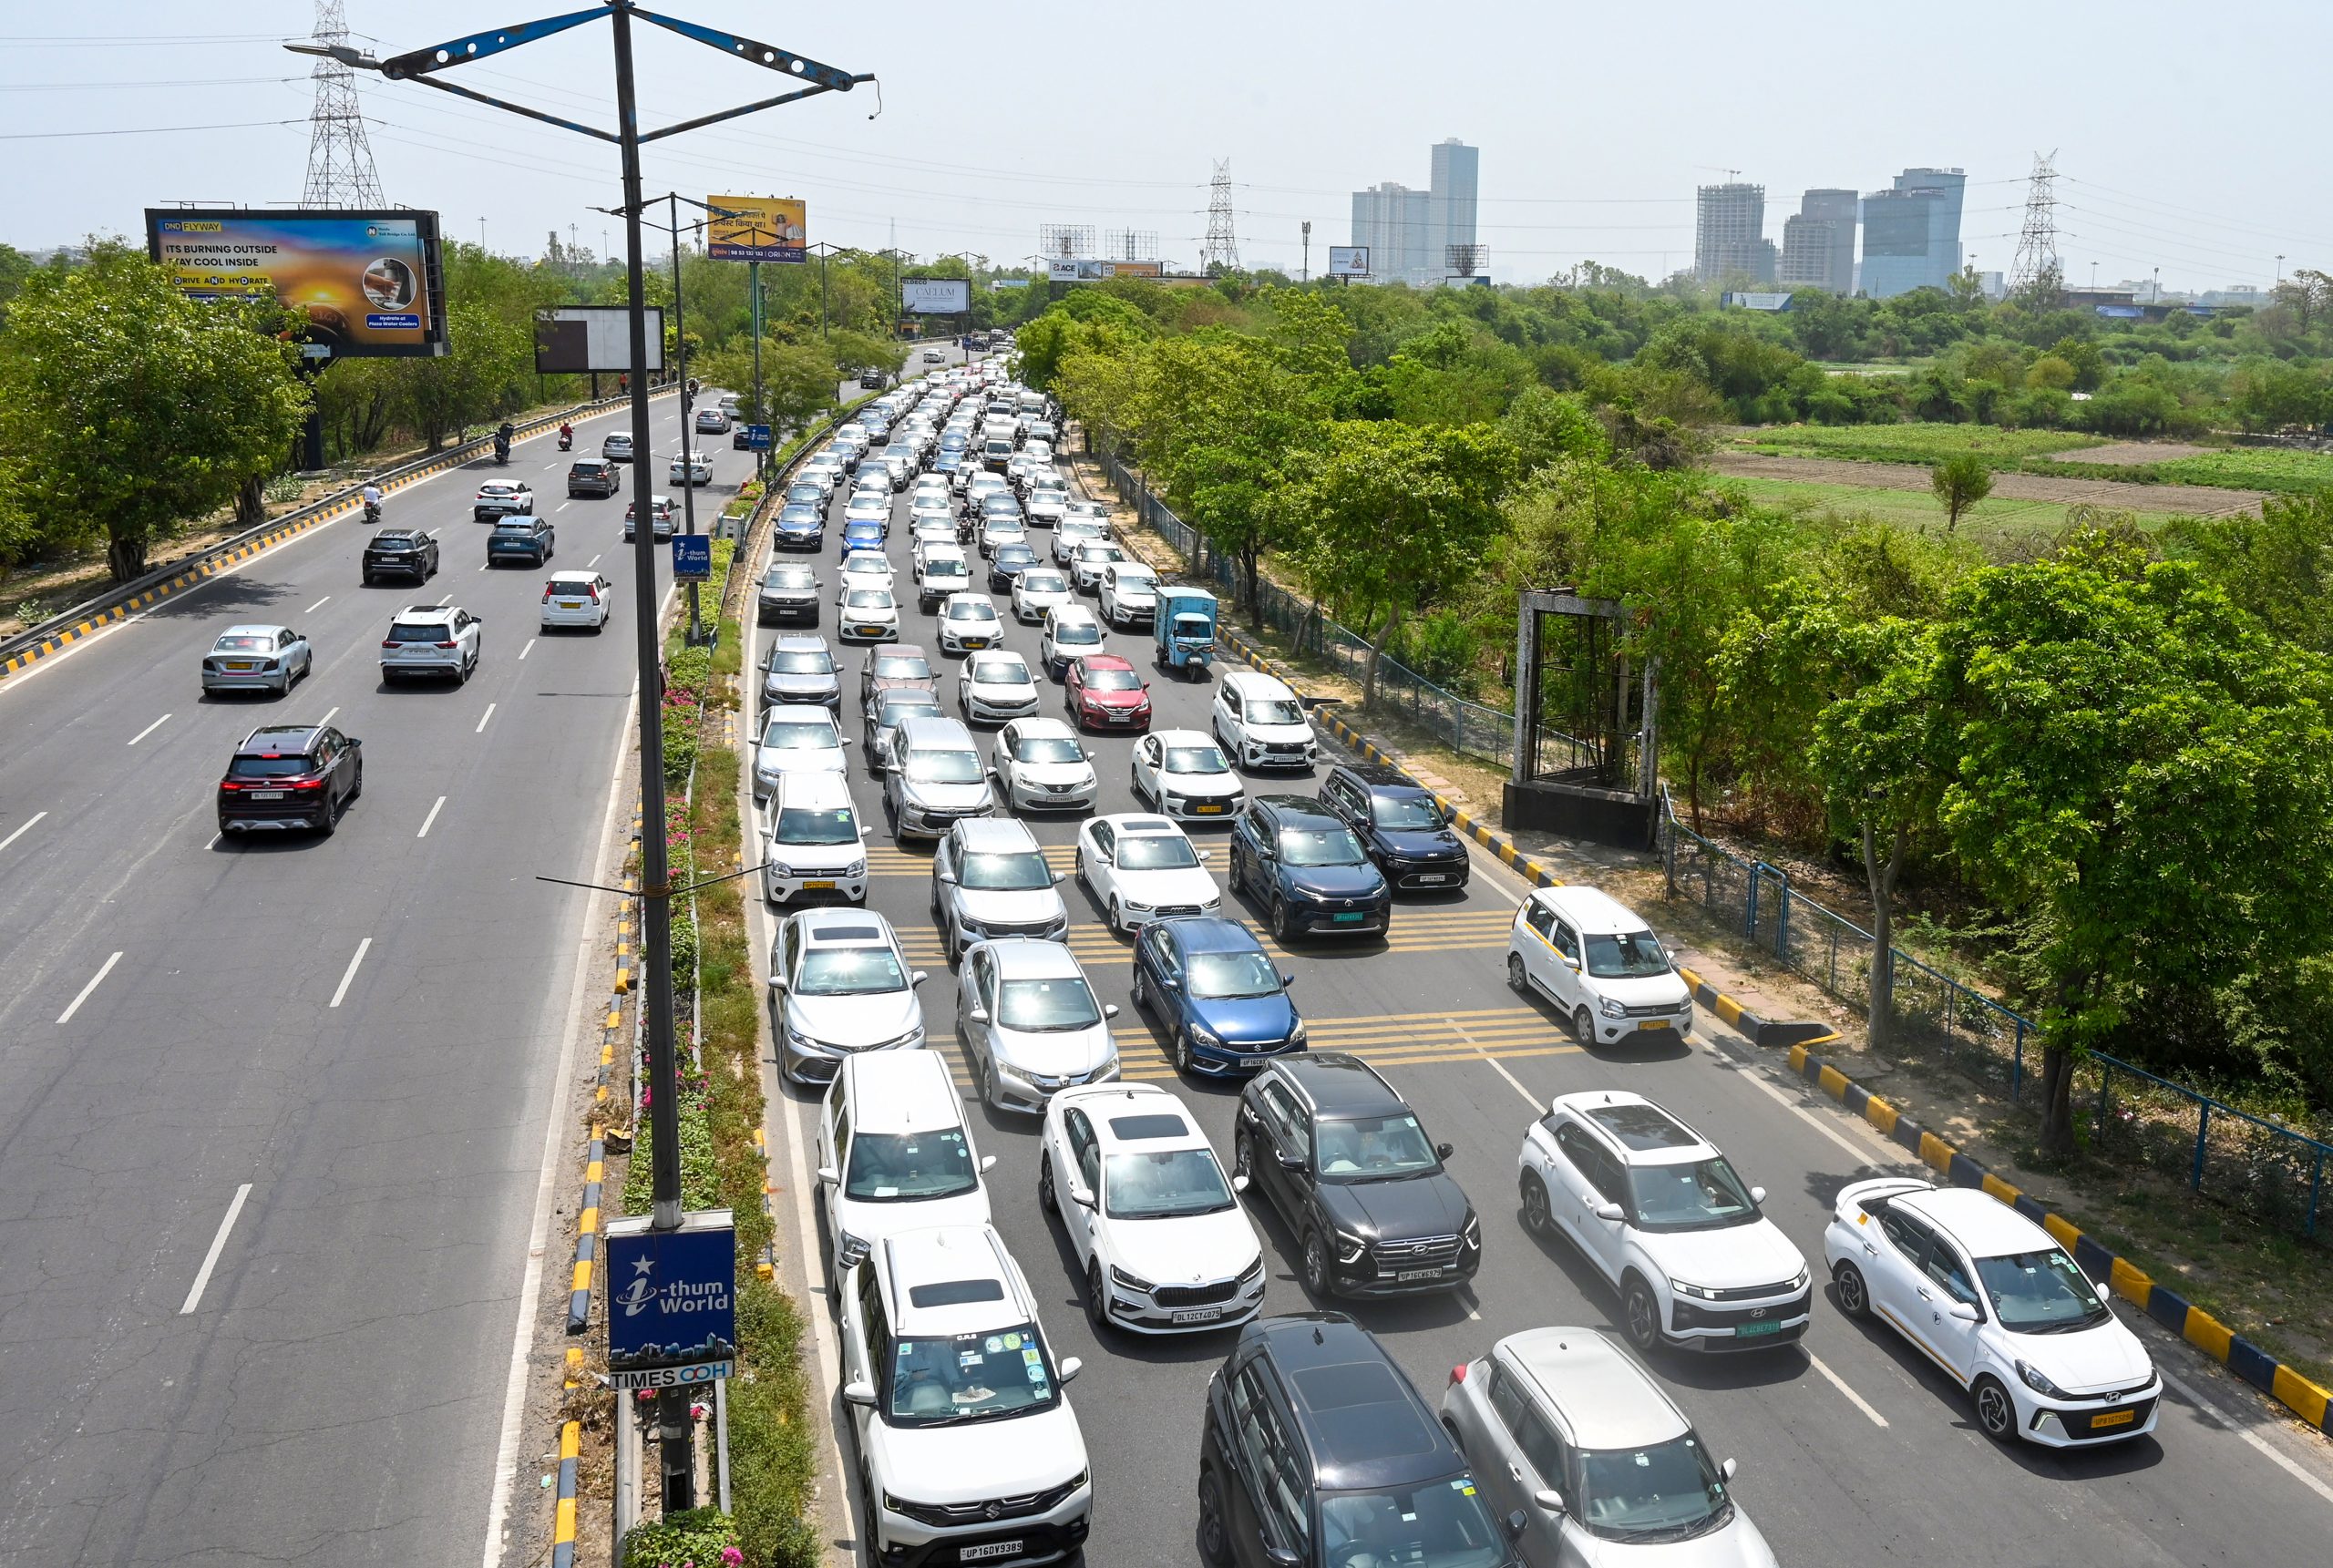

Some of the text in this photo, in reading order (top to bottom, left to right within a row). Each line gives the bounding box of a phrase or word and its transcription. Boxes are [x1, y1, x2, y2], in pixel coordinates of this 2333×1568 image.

[183, 222, 220, 231] FLYWAY
[166, 245, 278, 253] ITS BURNING OUTSIDE
[194, 258, 223, 266] COOL
[225, 258, 259, 266] INSIDE
[660, 1295, 729, 1314] World
[612, 1362, 726, 1389] TIMES OOH
[966, 1542, 1022, 1558] UP16DV9389
